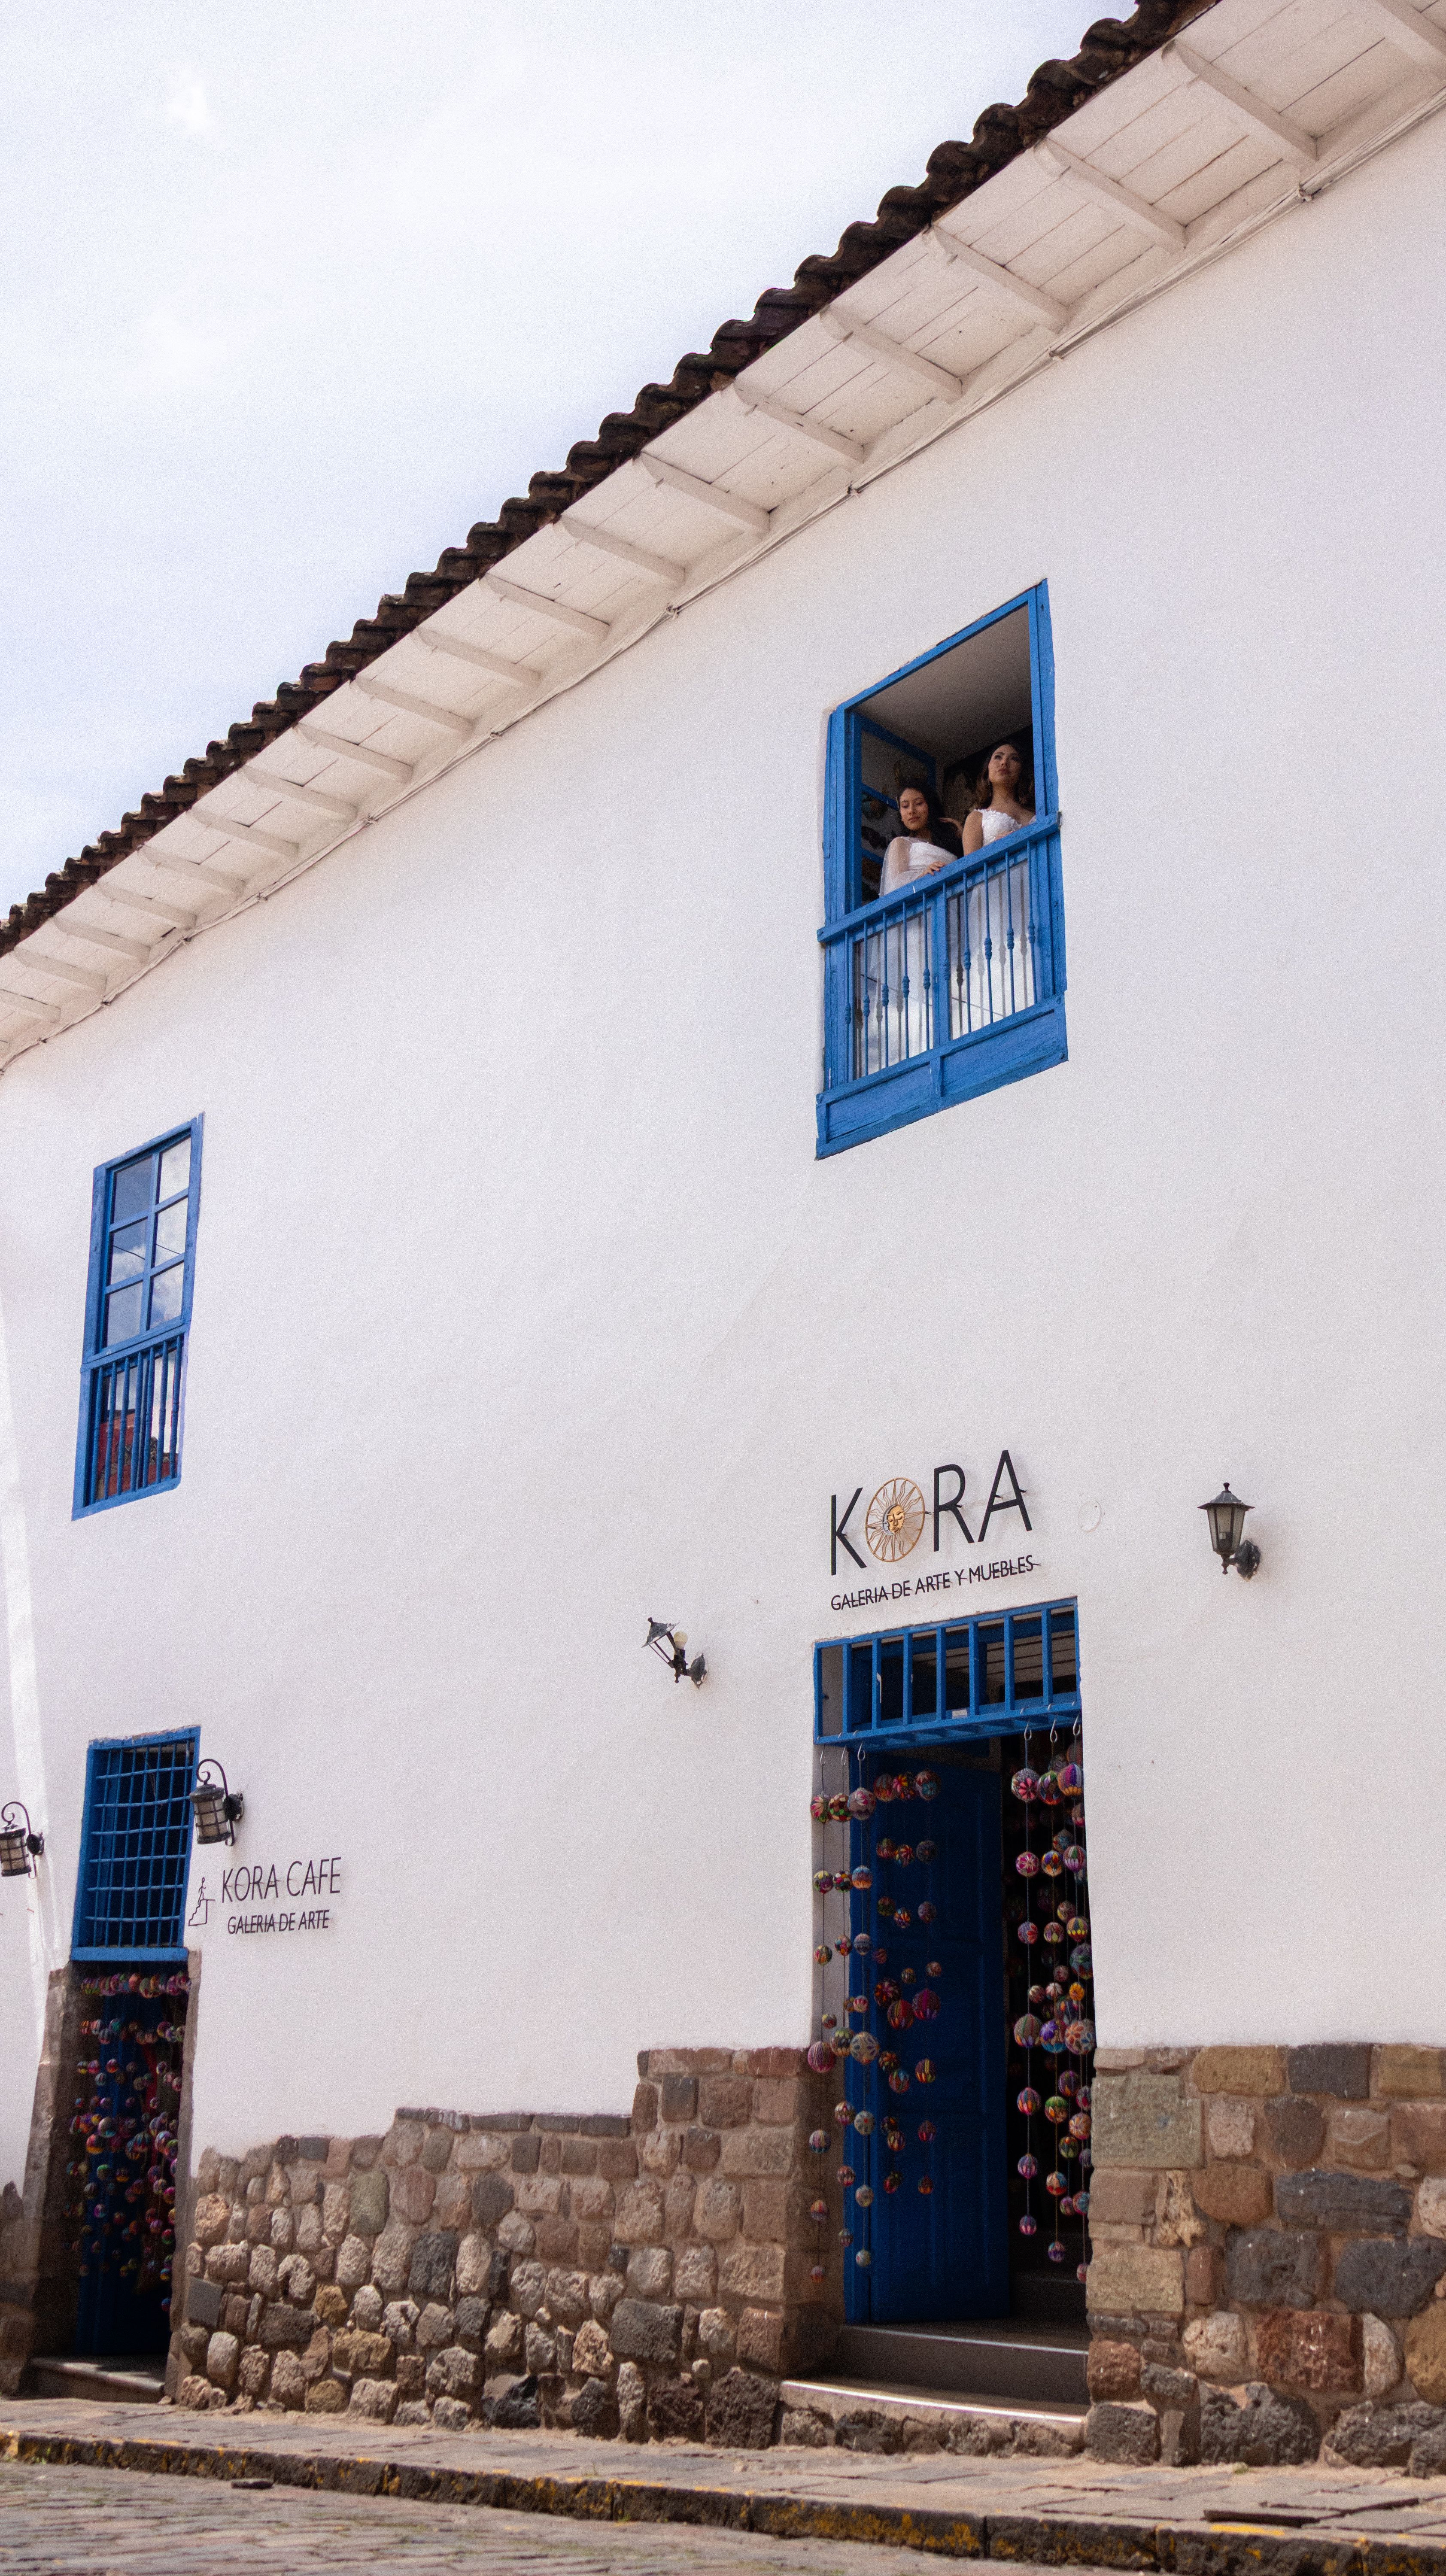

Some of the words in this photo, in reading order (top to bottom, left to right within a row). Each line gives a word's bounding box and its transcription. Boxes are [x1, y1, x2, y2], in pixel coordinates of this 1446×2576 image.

[831, 1449, 1033, 1576] KORA
[831, 1586, 888, 1611] GALERIA
[892, 1580, 910, 1599] DE
[915, 1572, 950, 1595] ARTE
[954, 1569, 964, 1586] Y
[969, 1555, 1034, 1584] MUEBLES
[222, 1864, 279, 1903] KORA
[286, 1857, 341, 1896] CAFE
[228, 1914, 275, 1934] GALERIA
[279, 1913, 295, 1932] DE
[298, 1909, 330, 1931] ARTE
